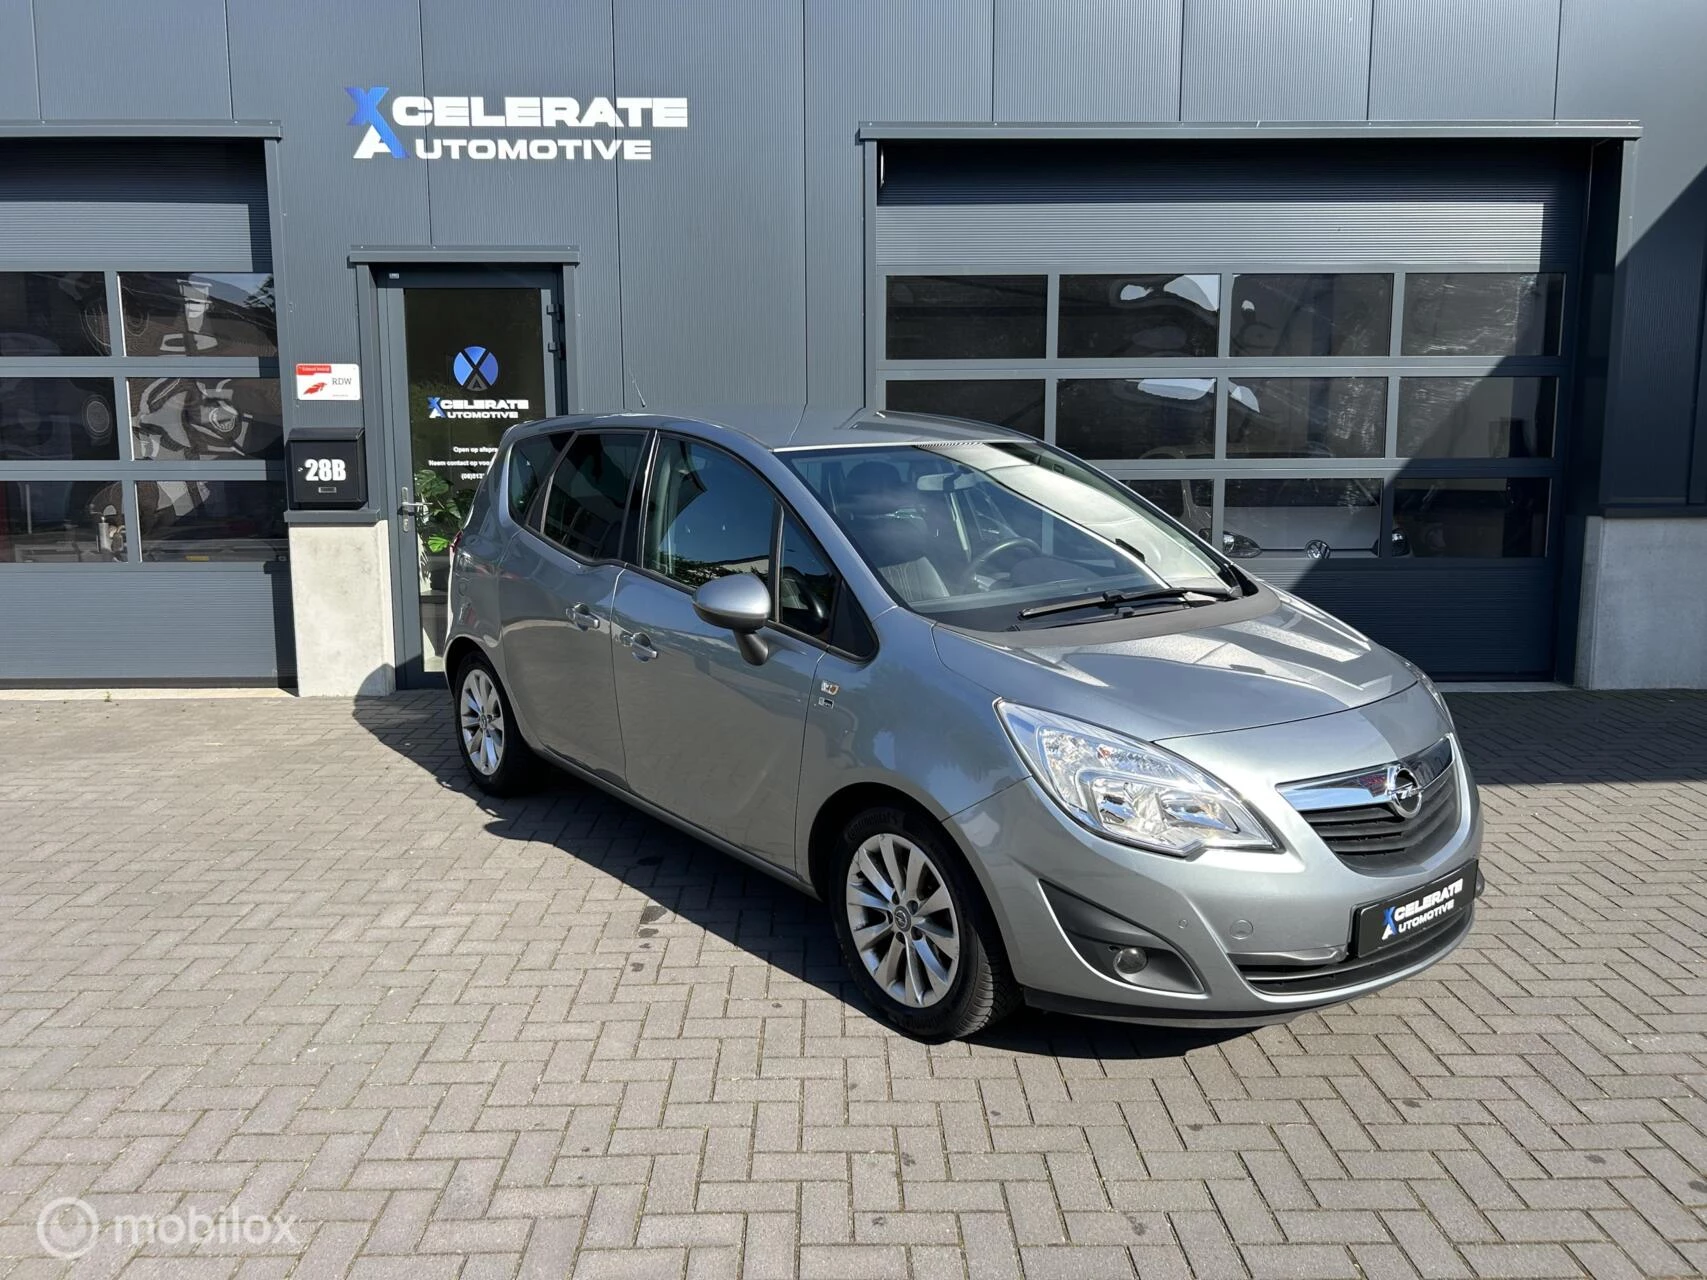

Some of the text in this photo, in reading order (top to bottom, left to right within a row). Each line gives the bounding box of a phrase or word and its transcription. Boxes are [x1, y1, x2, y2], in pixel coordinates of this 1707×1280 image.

[344, 87, 688, 128] XCELERATE
[353, 125, 652, 160] AUTOMOTIVE
[332, 377, 352, 385] RDW
[428, 397, 529, 410] XCELERATE
[429, 408, 519, 419] AUTOMOTIVE
[453, 446, 469, 454] Open
[304, 458, 346, 481] 28B
[1383, 878, 1463, 926] XCELERATE
[1382, 899, 1455, 941] AUTOMOTIVE
